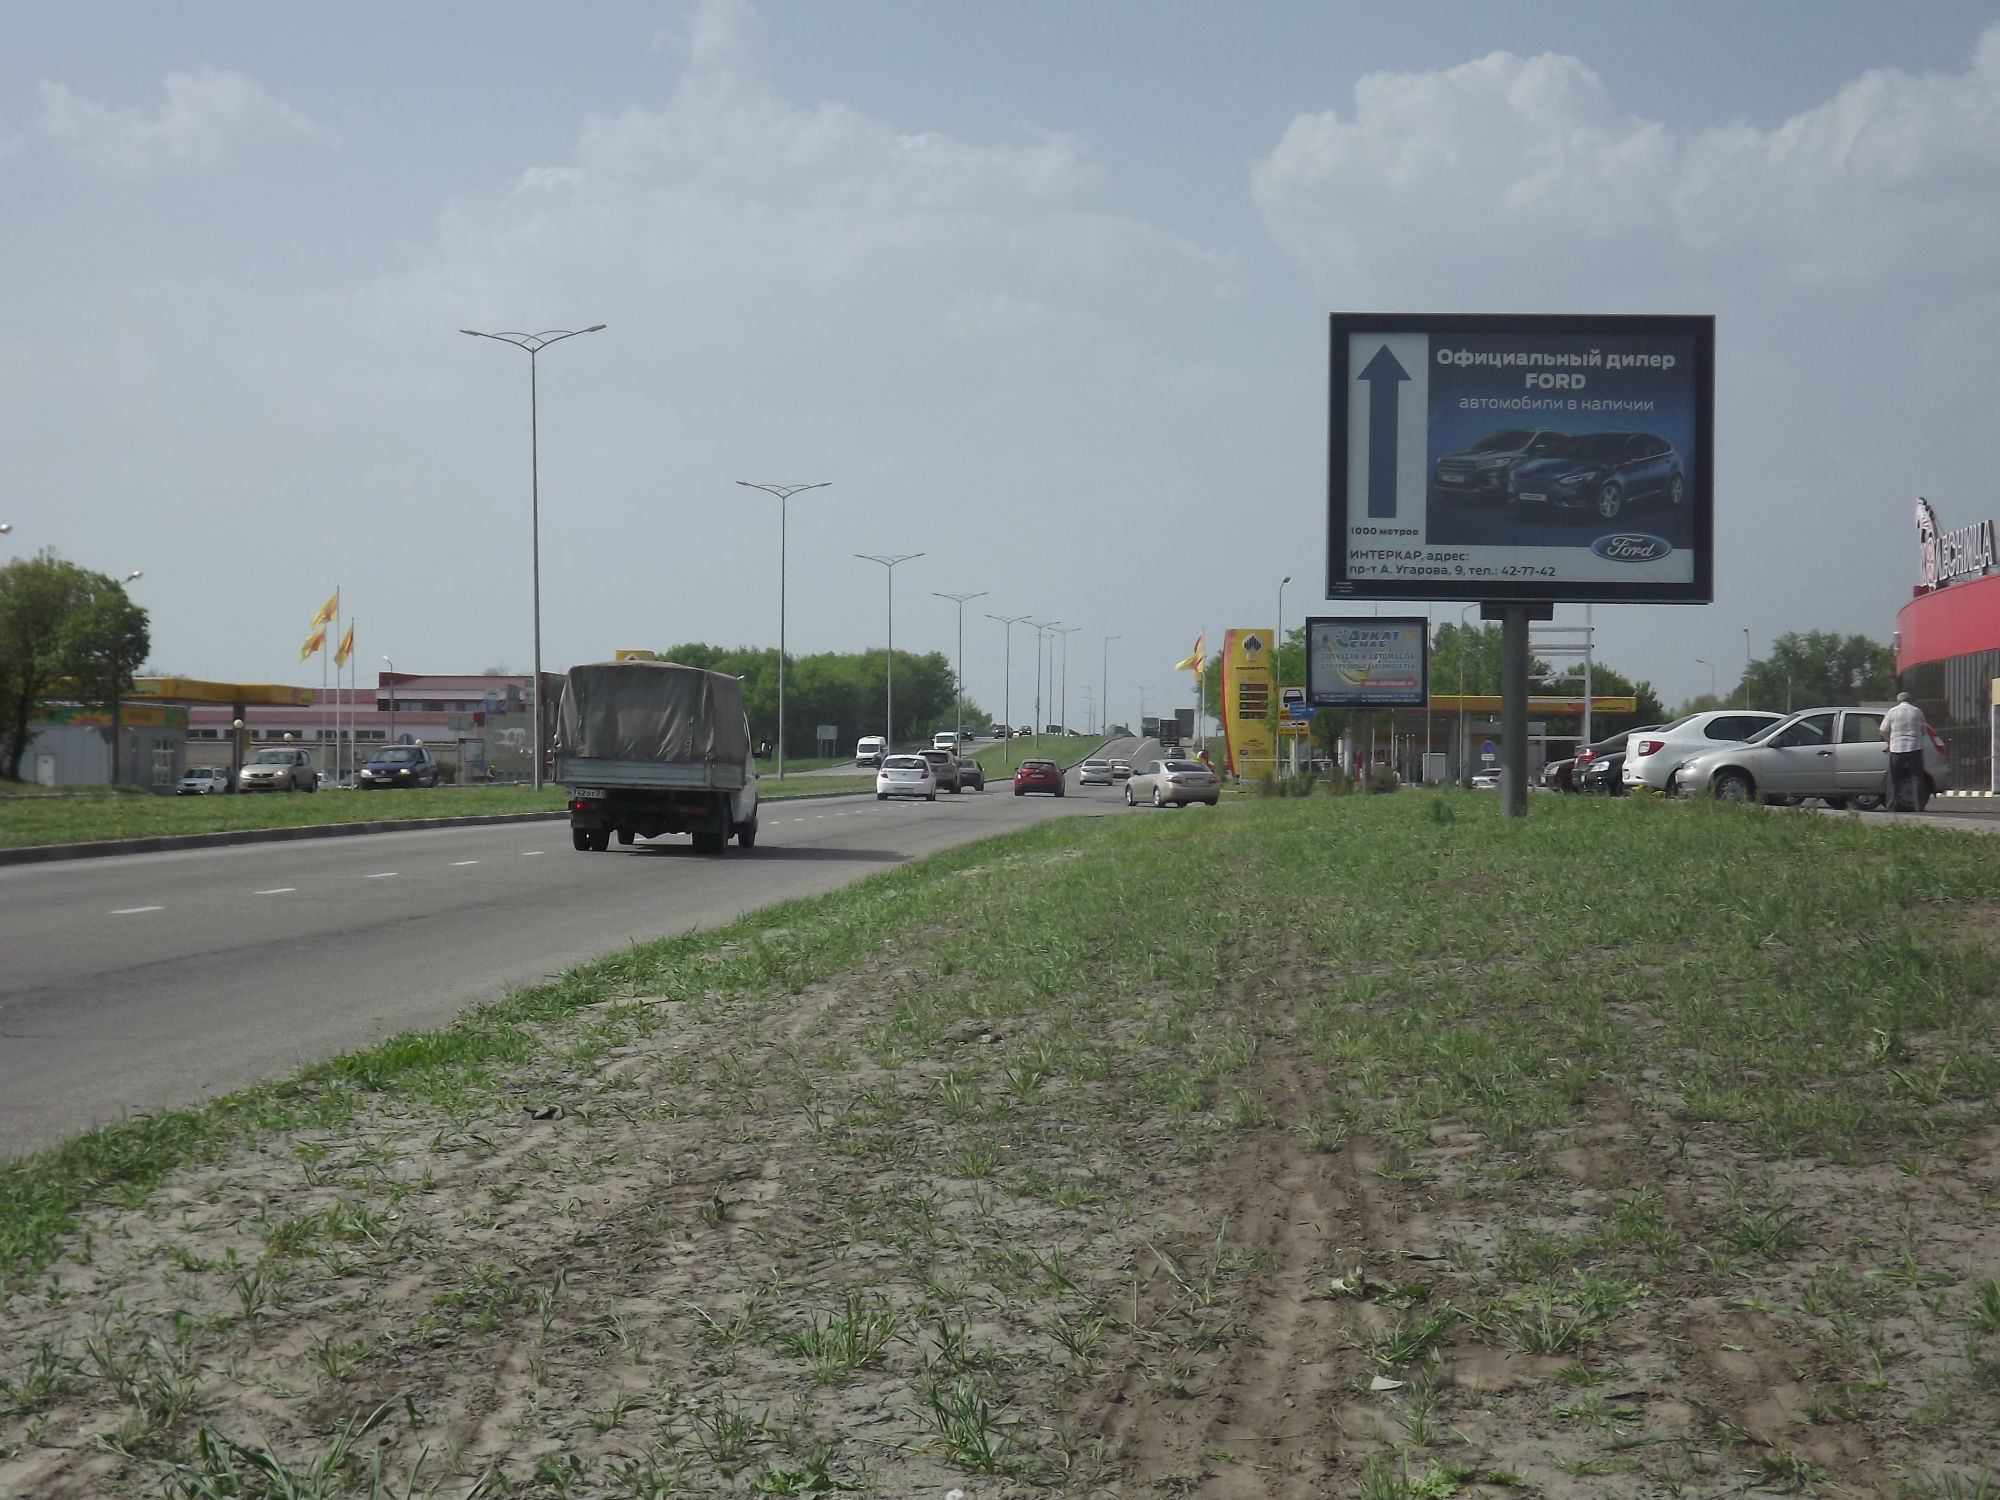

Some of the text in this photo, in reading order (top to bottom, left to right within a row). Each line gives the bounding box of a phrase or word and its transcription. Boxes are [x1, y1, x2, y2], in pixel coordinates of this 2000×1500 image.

[1437, 349, 1676, 370] Официальный дилер
[1525, 373, 1587, 389] FORD
[1459, 396, 1655, 411] автомобили в наличии
[1351, 527, 1419, 537] 1000 метров
[1607, 537, 1655, 557] Ford
[1350, 550, 1470, 563] ИНТЕРКАР, адрес:
[1350, 566, 1556, 576] пр-т А. Угарова, 9, тел.: 42-77-42
[1348, 629, 1400, 640] ДУКАТ
[1350, 640, 1388, 648] СНАБ
